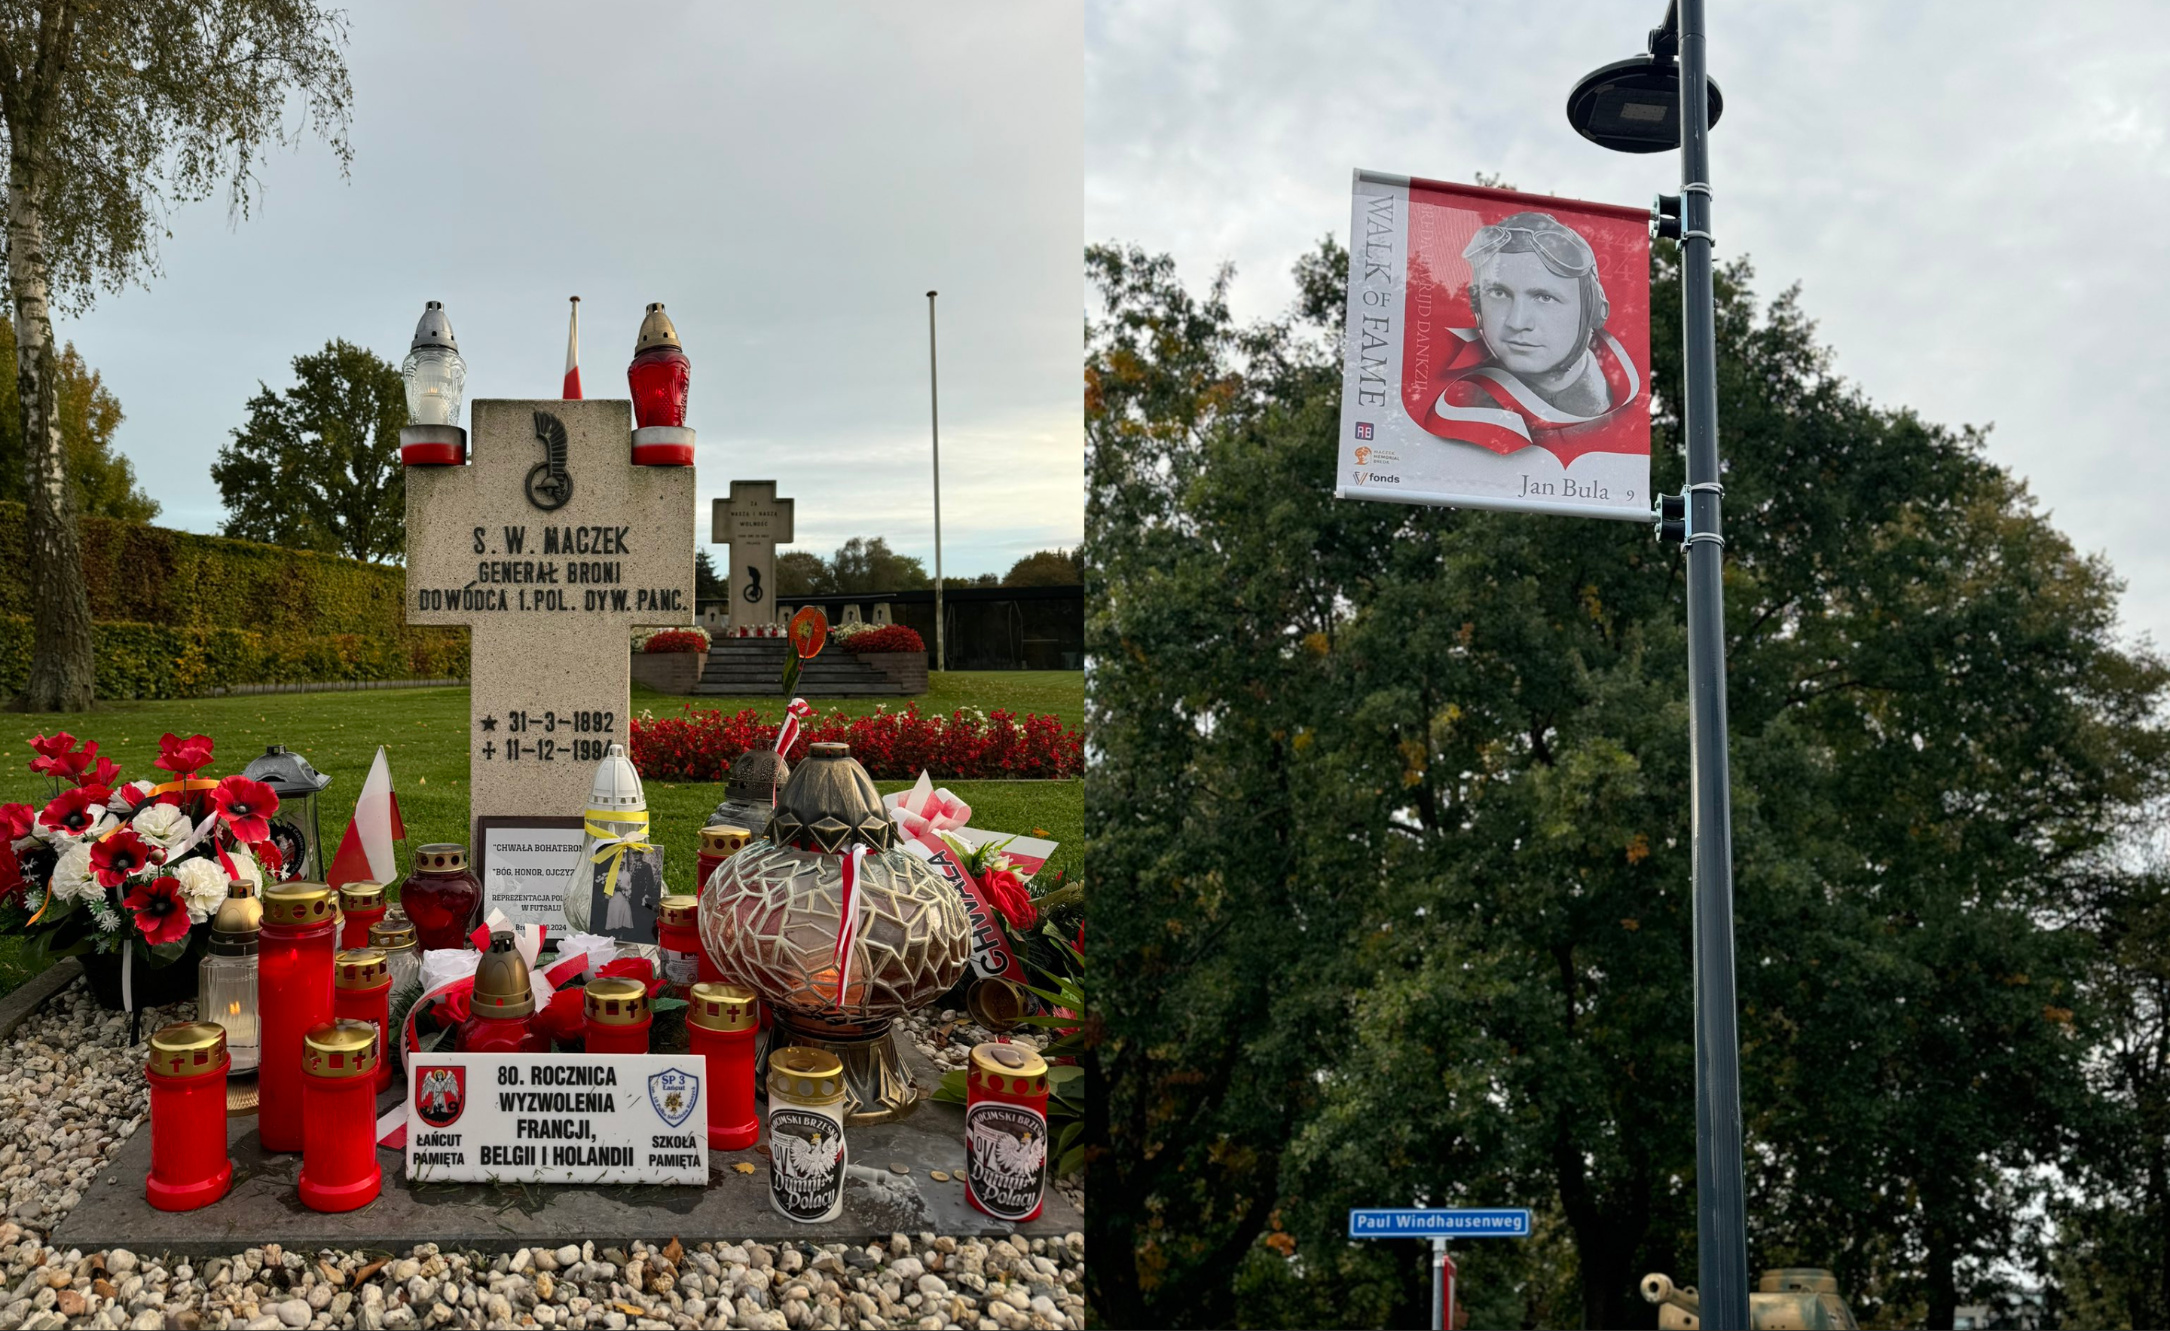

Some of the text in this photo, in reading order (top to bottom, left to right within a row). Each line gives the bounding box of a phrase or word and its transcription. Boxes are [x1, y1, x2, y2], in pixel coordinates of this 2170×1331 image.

[1358, 194, 1394, 407] WALK OF FAME
[1518, 475, 1635, 501] Jan Bula 9
[544, 526, 630, 554] MACZEK
[479, 561, 621, 584] GENERAŁ BRONI
[419, 580, 509, 611] DOWÓDCA
[584, 589, 631, 611] DYW.
[637, 589, 689, 611] PANC.
[514, 868, 544, 877] HONOR,
[492, 894, 550, 902] REPREZENTACJA
[497, 1065, 617, 1086] 80. ROCZNICA
[661, 1075, 686, 1085] SP 3
[499, 1092, 615, 1113] WYZWOLENIA
[416, 1130, 462, 1147] ŁAŃCUT
[516, 1119, 597, 1143] FRANCJI,
[652, 1134, 697, 1149] SZKOŁA
[413, 1152, 465, 1168] PAMIĘTA
[480, 1146, 634, 1167] BELGII I HOLANDII
[649, 1153, 701, 1170] PAMIĘTA
[1357, 1214, 1522, 1230] Paul Windhausenweg
